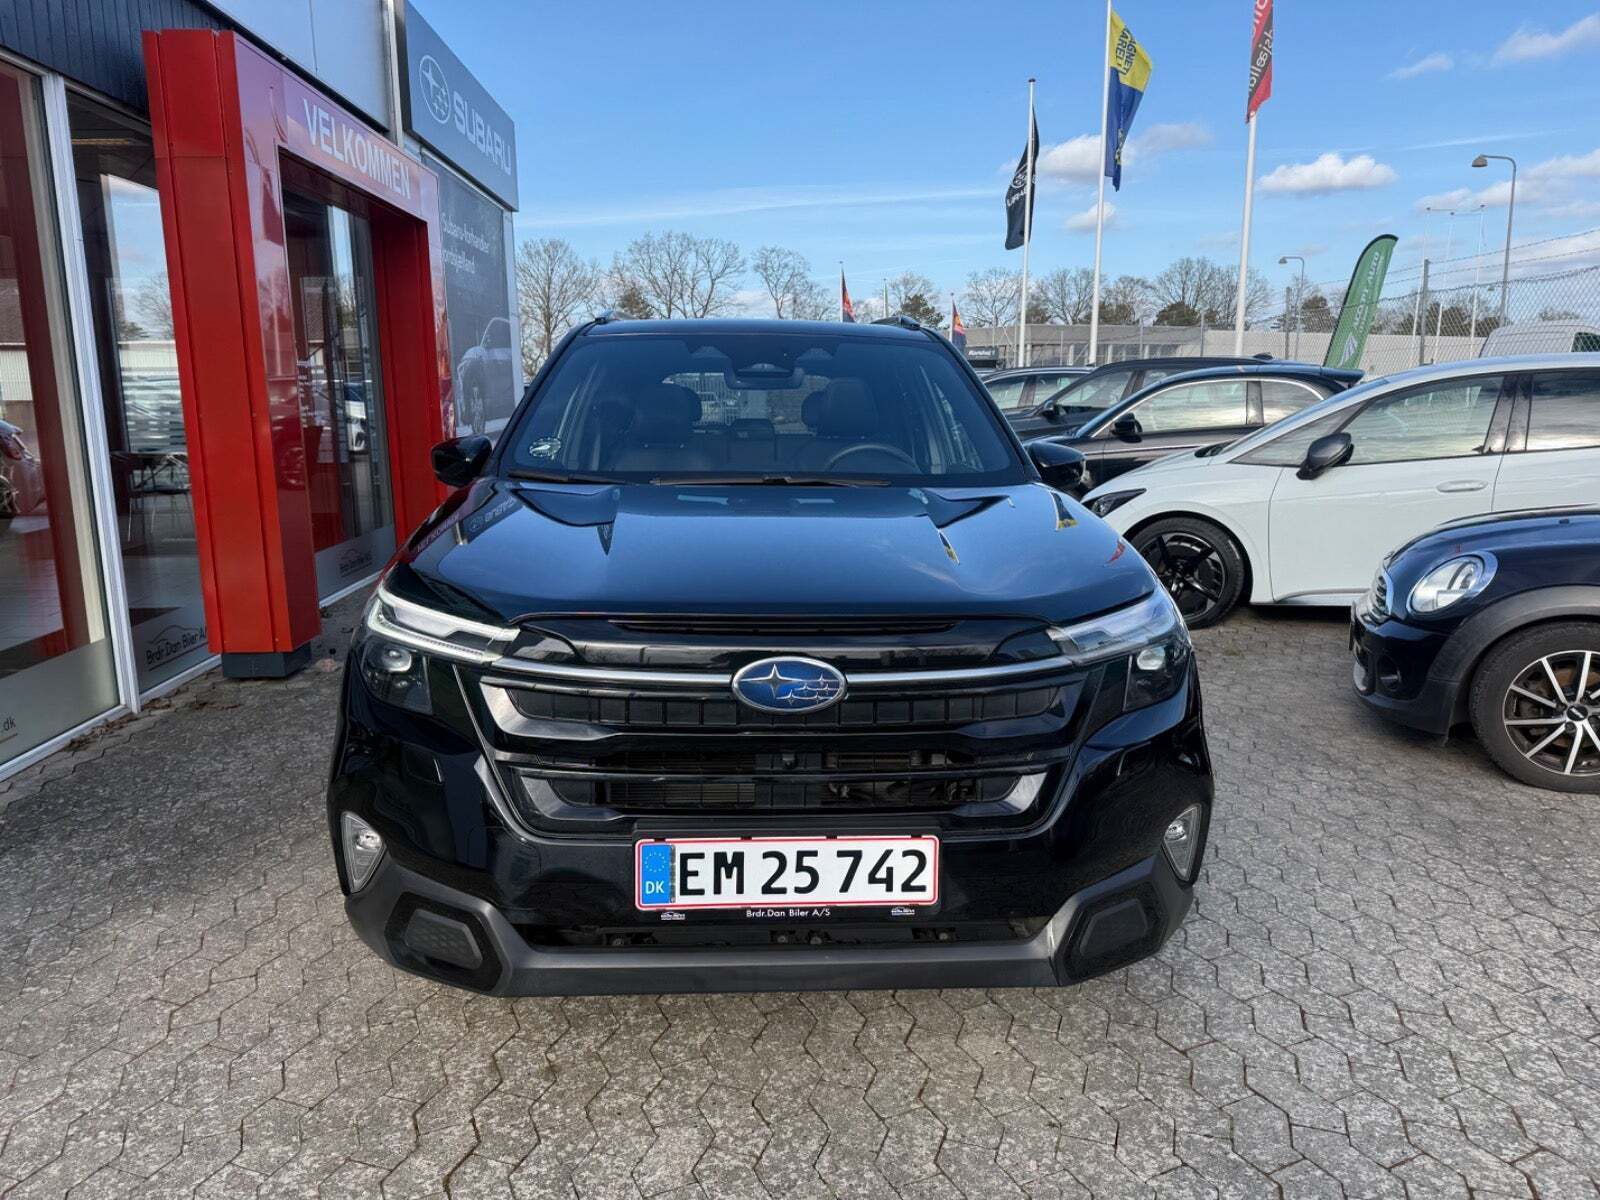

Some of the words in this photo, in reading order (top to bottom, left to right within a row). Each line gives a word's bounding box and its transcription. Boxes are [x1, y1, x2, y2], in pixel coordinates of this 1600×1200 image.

[303, 99, 411, 200] VELKOMMEN
[453, 90, 512, 176] SUBARU
[1367, 251, 1380, 285] AUTO
[645, 880, 665, 894] DK
[680, 851, 745, 896] EM
[761, 850, 820, 895] 25
[836, 848, 927, 893] 742
[789, 908, 808, 917] Biler
[812, 907, 831, 917] A/S
